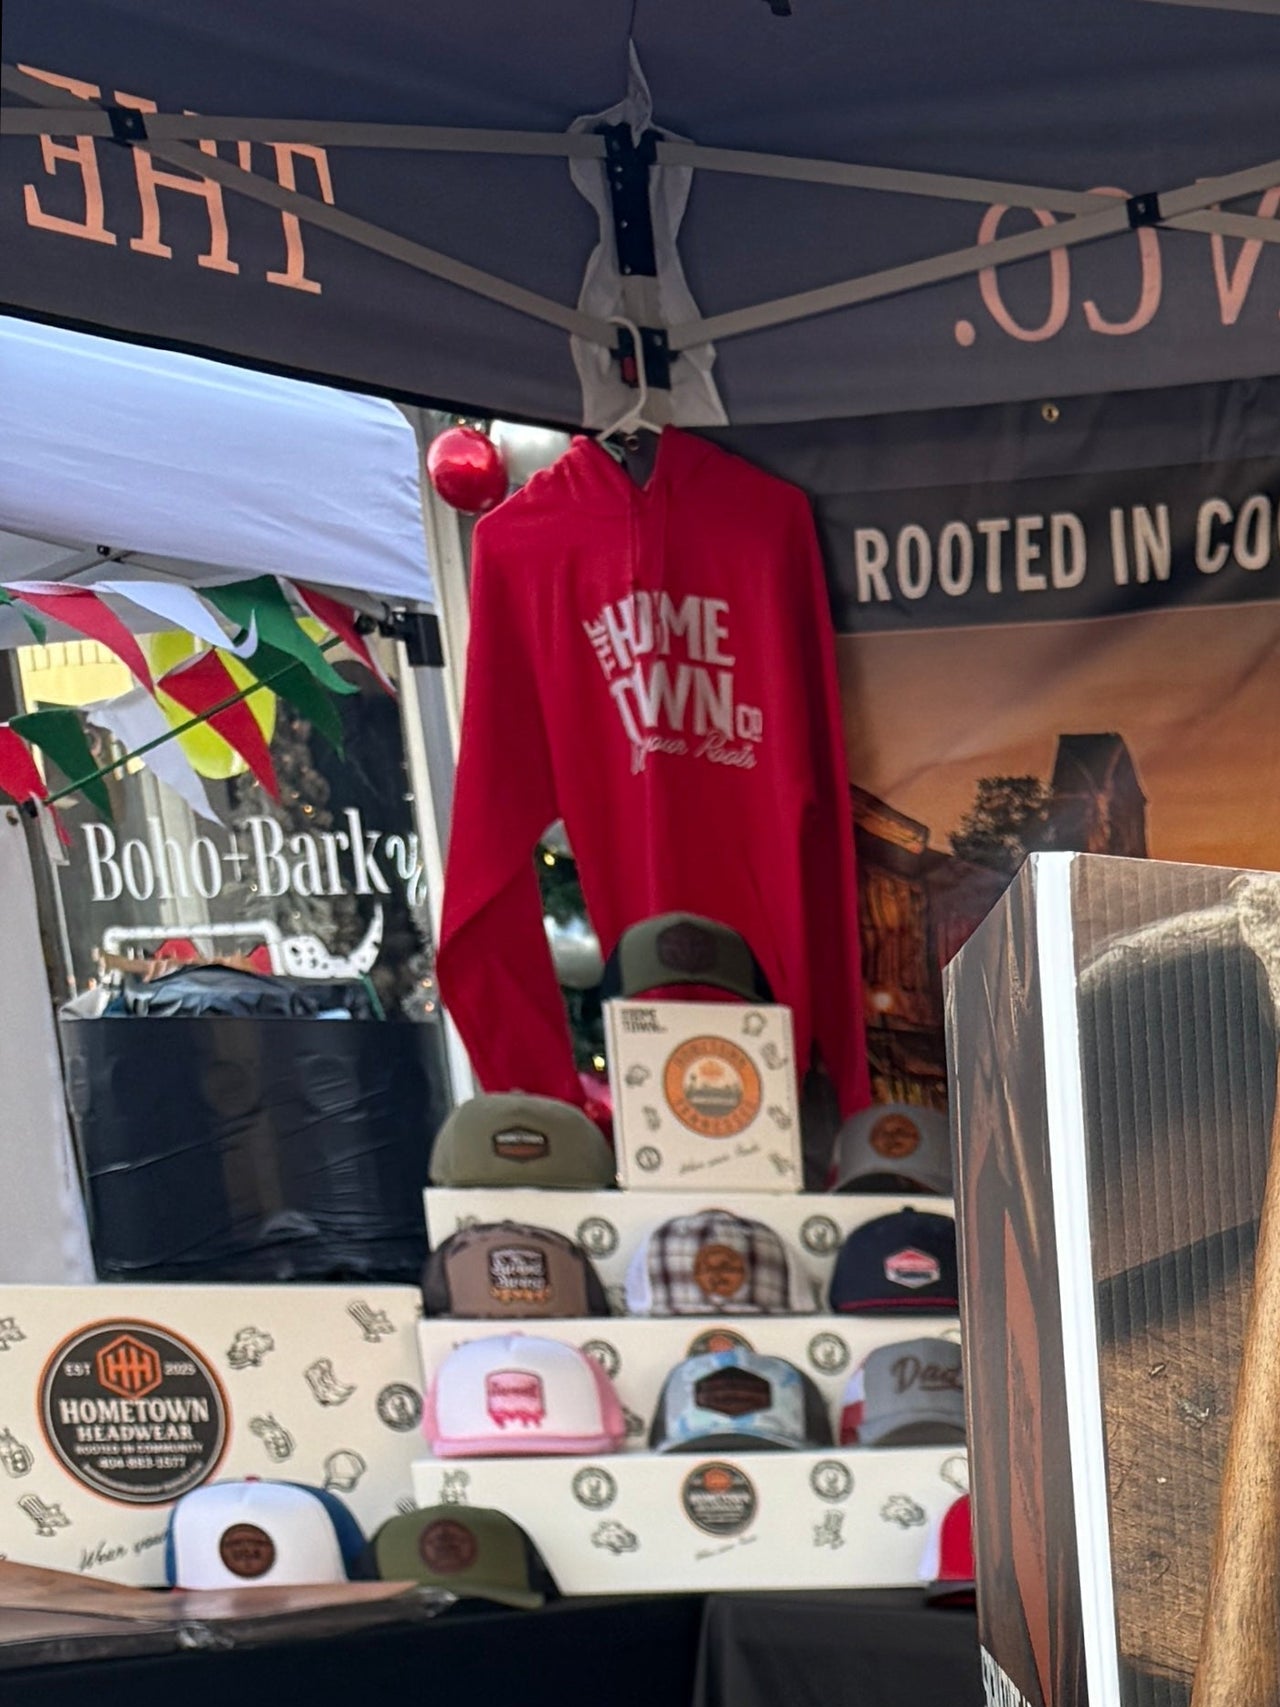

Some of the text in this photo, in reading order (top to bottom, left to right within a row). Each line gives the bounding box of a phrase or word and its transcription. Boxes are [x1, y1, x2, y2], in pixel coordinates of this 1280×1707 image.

[855, 514, 1088, 602] ROOTED
[1111, 505, 1171, 587] IN
[610, 659, 734, 742] TWN
[58, 1398, 210, 1425] HOMETOWN
[76, 1425, 194, 1442] HEADWEAR
